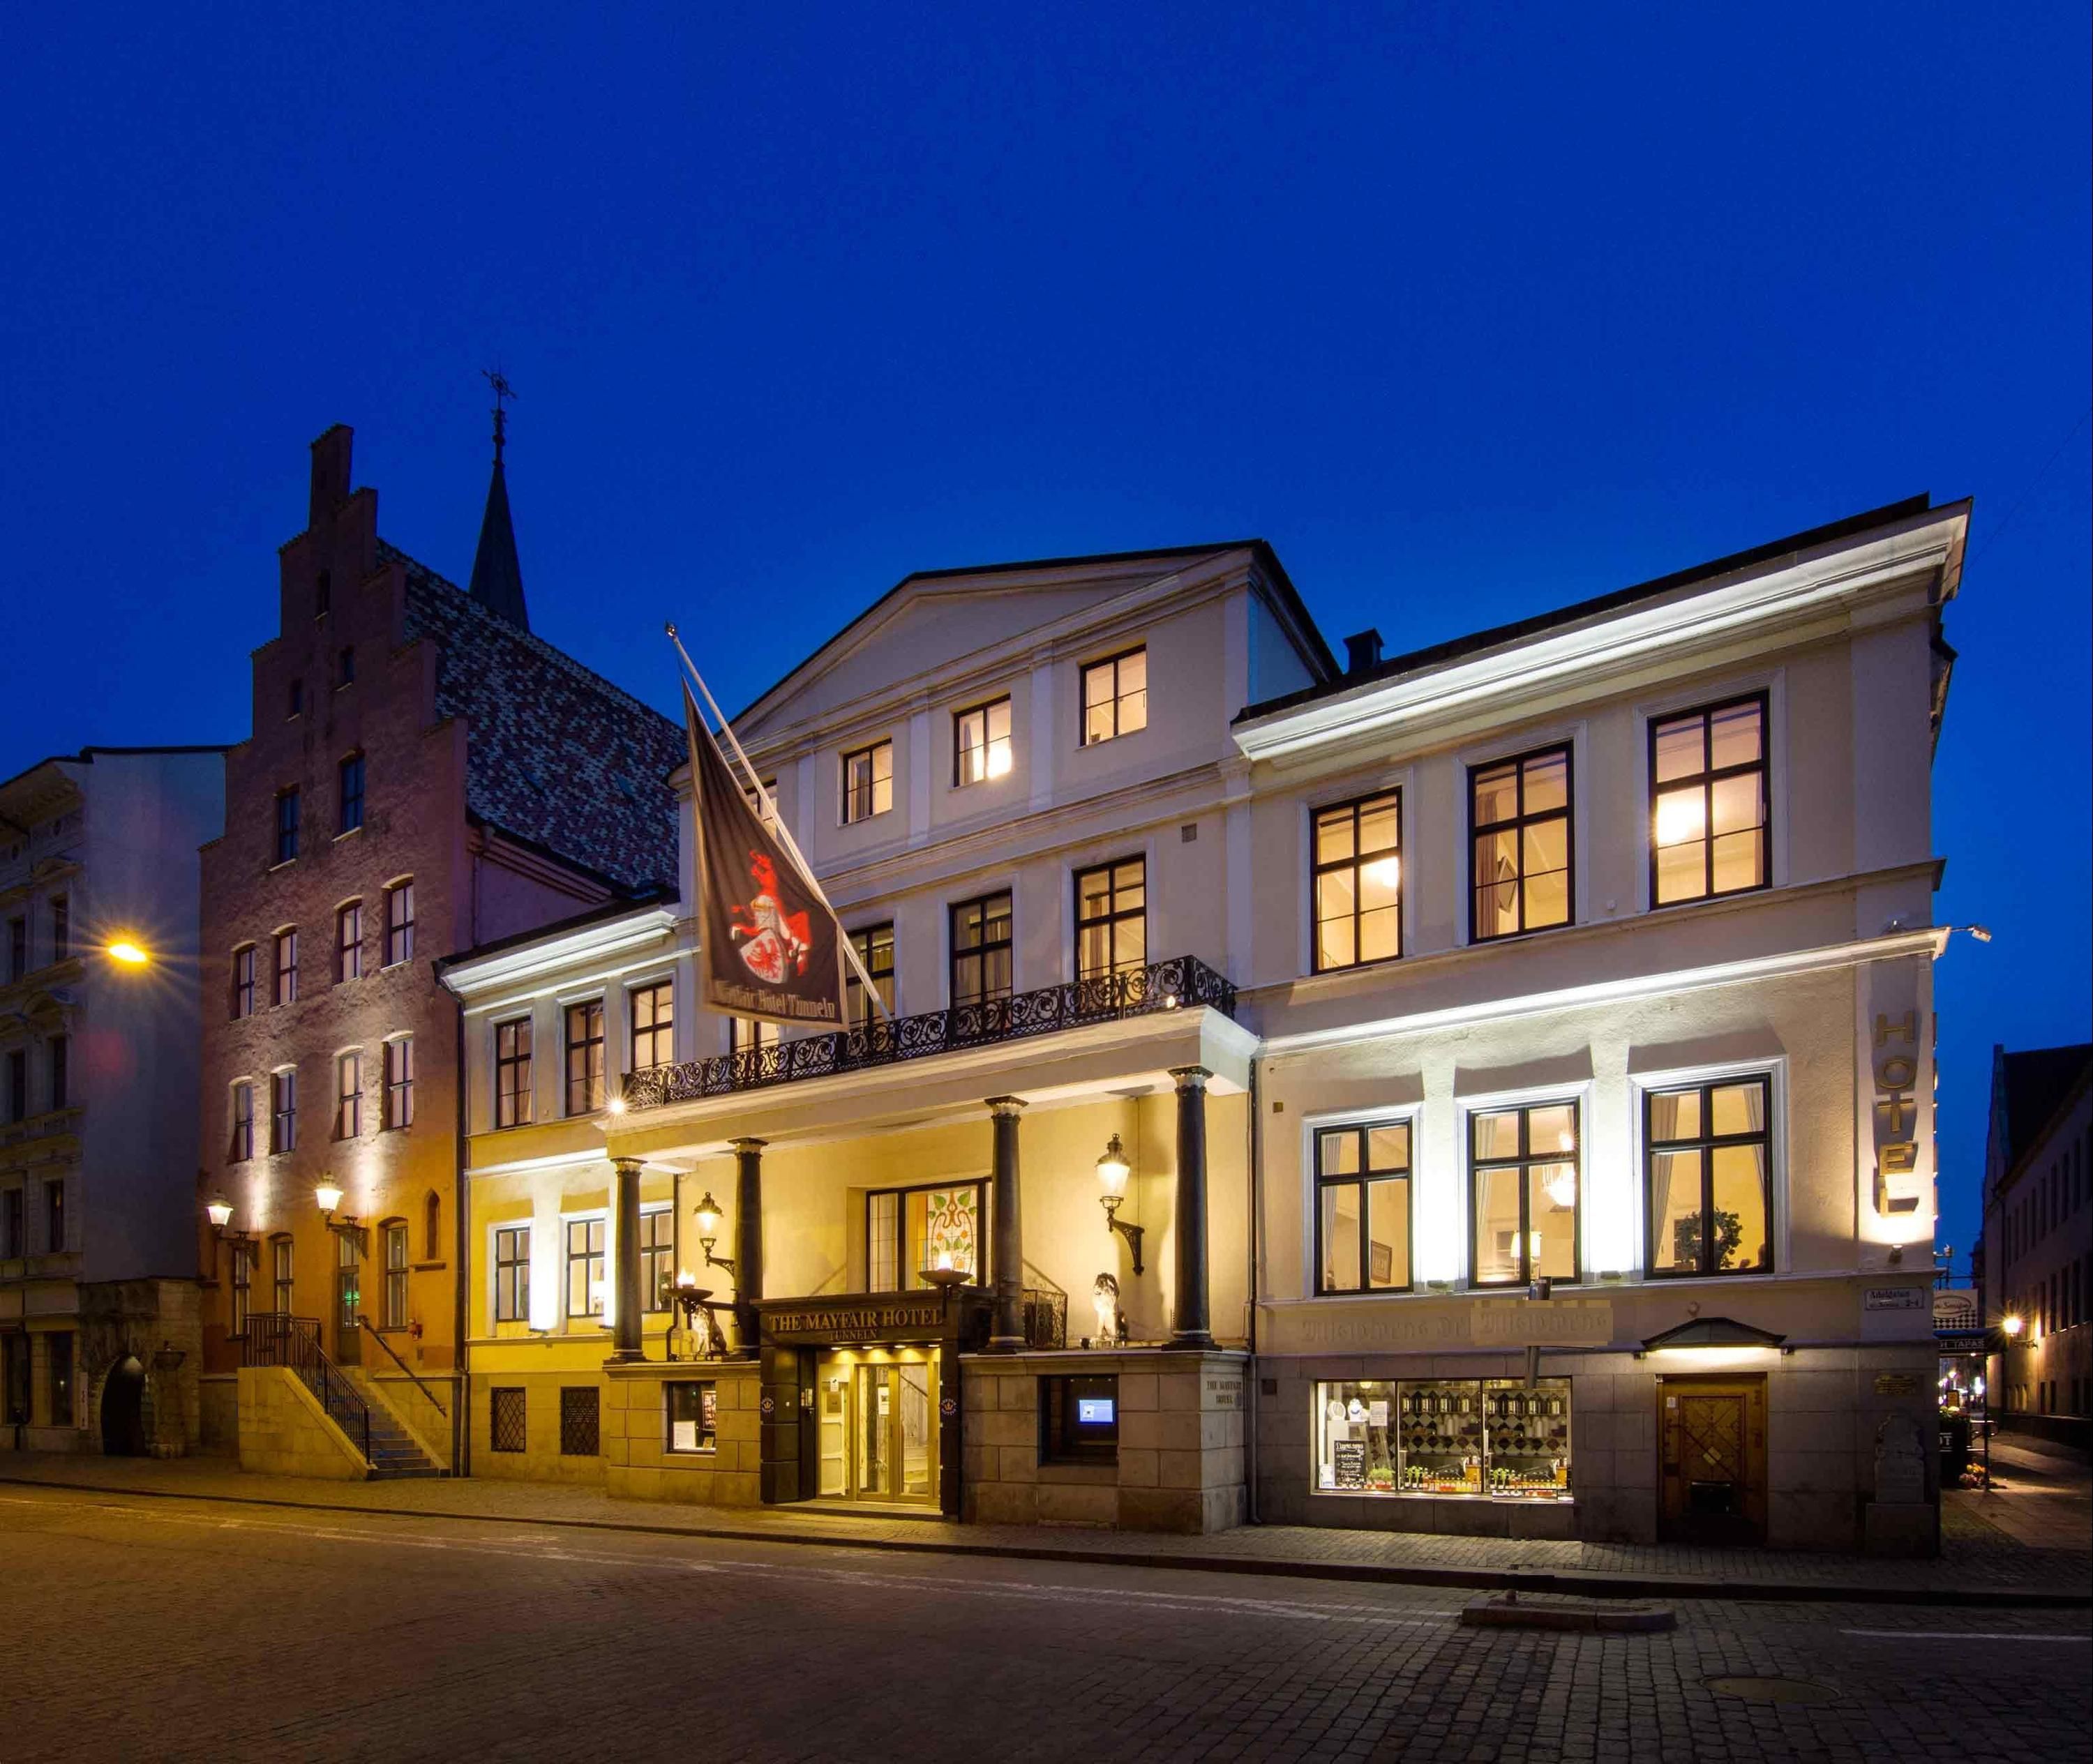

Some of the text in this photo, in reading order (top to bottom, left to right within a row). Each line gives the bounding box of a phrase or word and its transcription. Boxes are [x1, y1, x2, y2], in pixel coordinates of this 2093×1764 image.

[788, 994, 835, 1018] Tunneln
[1876, 1009, 1919, 1218] HOTEL
[769, 1308, 943, 1332] THE MAYFAIR HOTEL
[828, 1328, 878, 1341] TUNNELN
